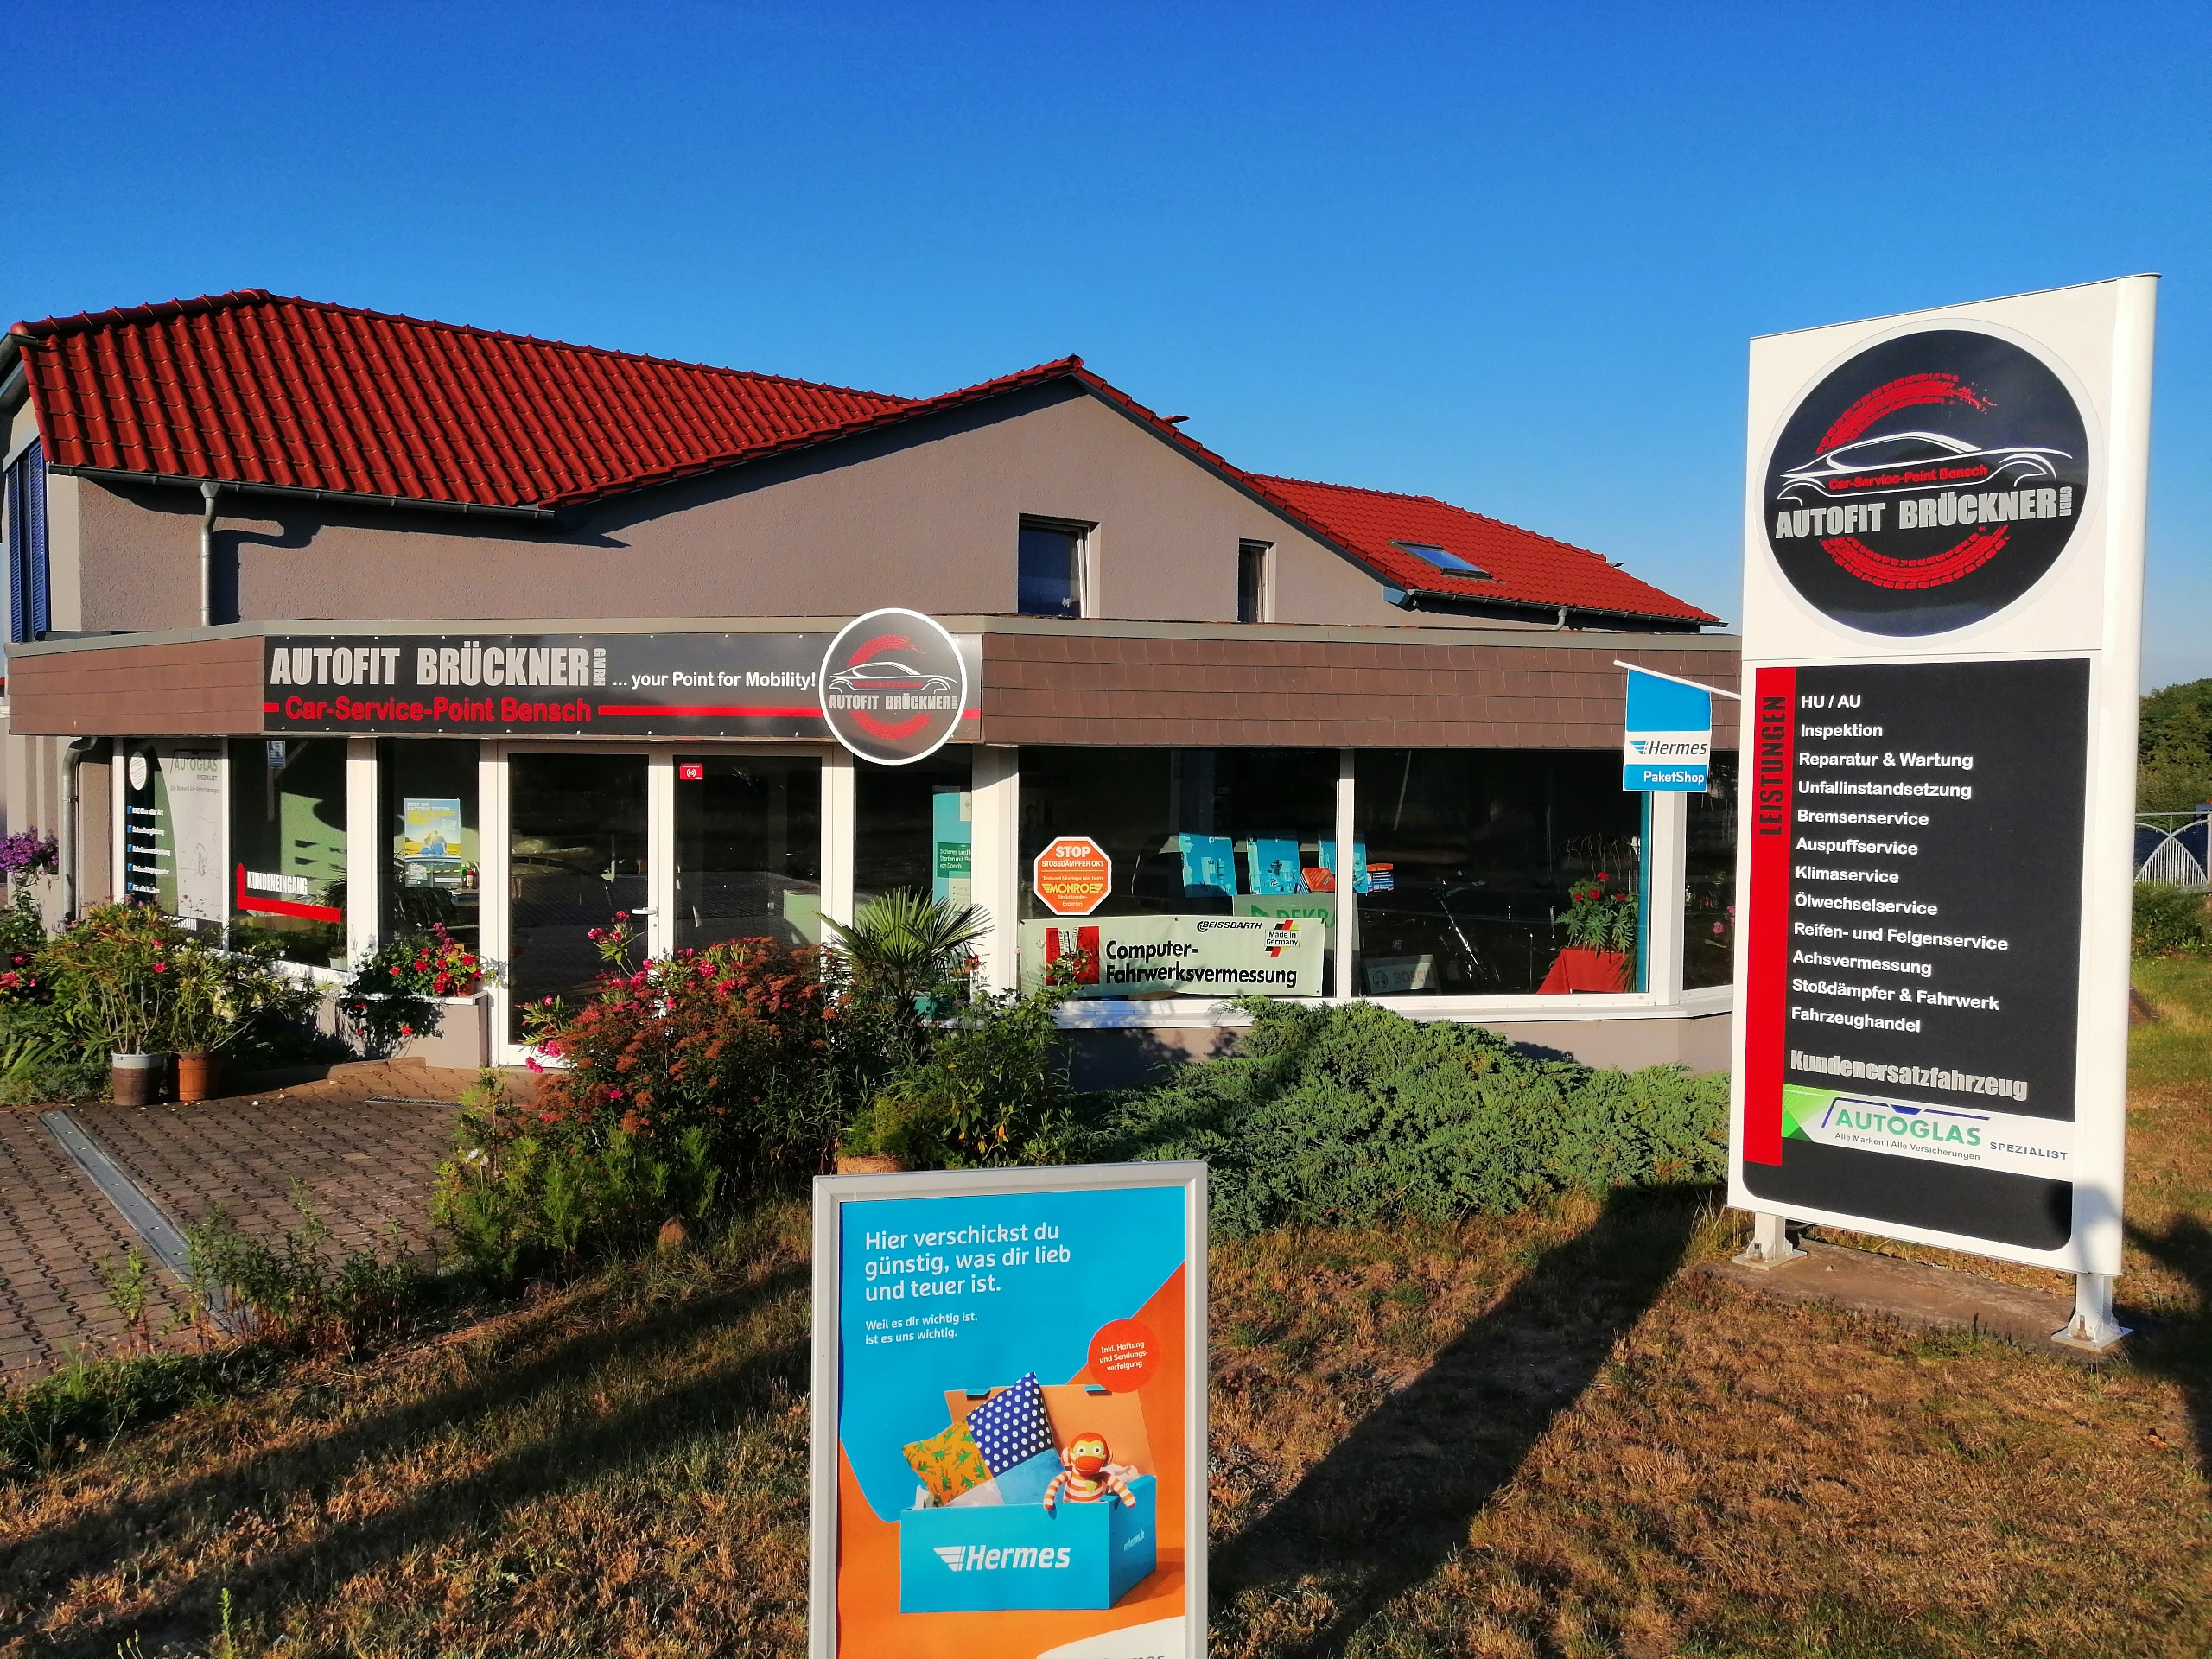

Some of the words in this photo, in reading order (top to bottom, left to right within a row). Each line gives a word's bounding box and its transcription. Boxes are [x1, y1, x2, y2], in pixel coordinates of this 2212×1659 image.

[1828, 468, 1937, 491] Car-Service-Point
[1938, 465, 1988, 480] Bensch
[1776, 503, 1885, 539] AUTOFIT
[1899, 487, 2057, 530] BRÜCKNER
[270, 647, 401, 686] AUTOFIT
[417, 641, 590, 687] BRÜCKNER
[593, 648, 607, 686] GMBH
[632, 673, 669, 690] your
[672, 671, 715, 688] Point
[717, 671, 741, 688] for
[746, 671, 816, 691] Mobility!
[285, 696, 494, 721] Car-Service-Point
[501, 697, 592, 722] Bensch
[829, 694, 880, 709] AUTOFIT
[886, 693, 951, 710] BRÜCKNER
[1801, 695, 1825, 709] HU
[1838, 694, 1861, 709] AU
[1801, 724, 1883, 741] Inspektion
[1649, 741, 1707, 755] Hermes
[175, 759, 218, 772] AUTOGLAS
[1758, 696, 1786, 836] LEISTUNGEN
[1799, 753, 1878, 769] Reparatur
[1883, 753, 1896, 766] &
[1900, 753, 1974, 770] Wartung
[1643, 770, 1705, 785] PaketShop
[1798, 780, 1972, 800] Unfallinstandsetzung
[1797, 810, 1929, 826] Bremsenservice
[1055, 845, 1090, 858] STOP
[1796, 837, 1918, 856] Auspuffservice
[246, 871, 308, 896] KUNDENEINGANG
[1796, 866, 1899, 884] Klimaservice
[1049, 883, 1096, 893] MONROE
[1795, 892, 1937, 916] Ölwechselservice
[1202, 921, 1263, 930] BEISSBARTH
[1266, 938, 1299, 947] Germany
[1794, 922, 1848, 938] Reifen-
[1853, 927, 1883, 942] und
[1887, 930, 2008, 951] Felgenservice
[1106, 940, 1198, 963] Computer-
[1793, 950, 1932, 977] Achsvermessung
[1106, 961, 1297, 989] Fahrwerksvermessung
[1792, 978, 1895, 1001] Stoßdämpfer
[1899, 988, 1912, 1002] &
[1916, 989, 1999, 1011] Fahrwerk
[1791, 1007, 1921, 1033] Fahrzeughandel
[1790, 1049, 2028, 1102] Kundenersatzfahrzeug
[1835, 1109, 1981, 1147] AUTOGLAS
[1989, 1141, 2069, 1160] SPEZIALIST
[1834, 1132, 1851, 1141] Alle
[1853, 1135, 1884, 1146] Marken
[1891, 1141, 1908, 1150] Alle
[1910, 1143, 1980, 1160] Versicherungen
[866, 1230, 909, 1250] Hier
[913, 1224, 1028, 1247] verschickst
[1034, 1222, 1059, 1240] du
[865, 1253, 950, 1281] günstig,
[956, 1253, 995, 1269] was
[1002, 1247, 1029, 1266] dir
[1035, 1244, 1071, 1264] lieb
[866, 1280, 905, 1301] und
[911, 1279, 965, 1298] teuer
[971, 1274, 1001, 1293] ist.
[866, 1319, 888, 1331] Weil
[891, 1319, 903, 1328] es
[906, 1316, 918, 1327] dir
[922, 1312, 960, 1325] wichtig
[962, 1312, 977, 1323] ist,
[865, 1333, 879, 1344] ist
[881, 1334, 893, 1344] es
[895, 1332, 914, 1343] uns
[917, 1327, 958, 1340] wichtig.
[1099, 1355, 1113, 1363] und
[1114, 1351, 1148, 1361] Sendungs-
[1100, 1344, 1116, 1354] Inkl.
[1116, 1342, 1145, 1351] Haftung
[1107, 1361, 1142, 1372] verfolgung
[965, 1544, 1071, 1572] Hermes
